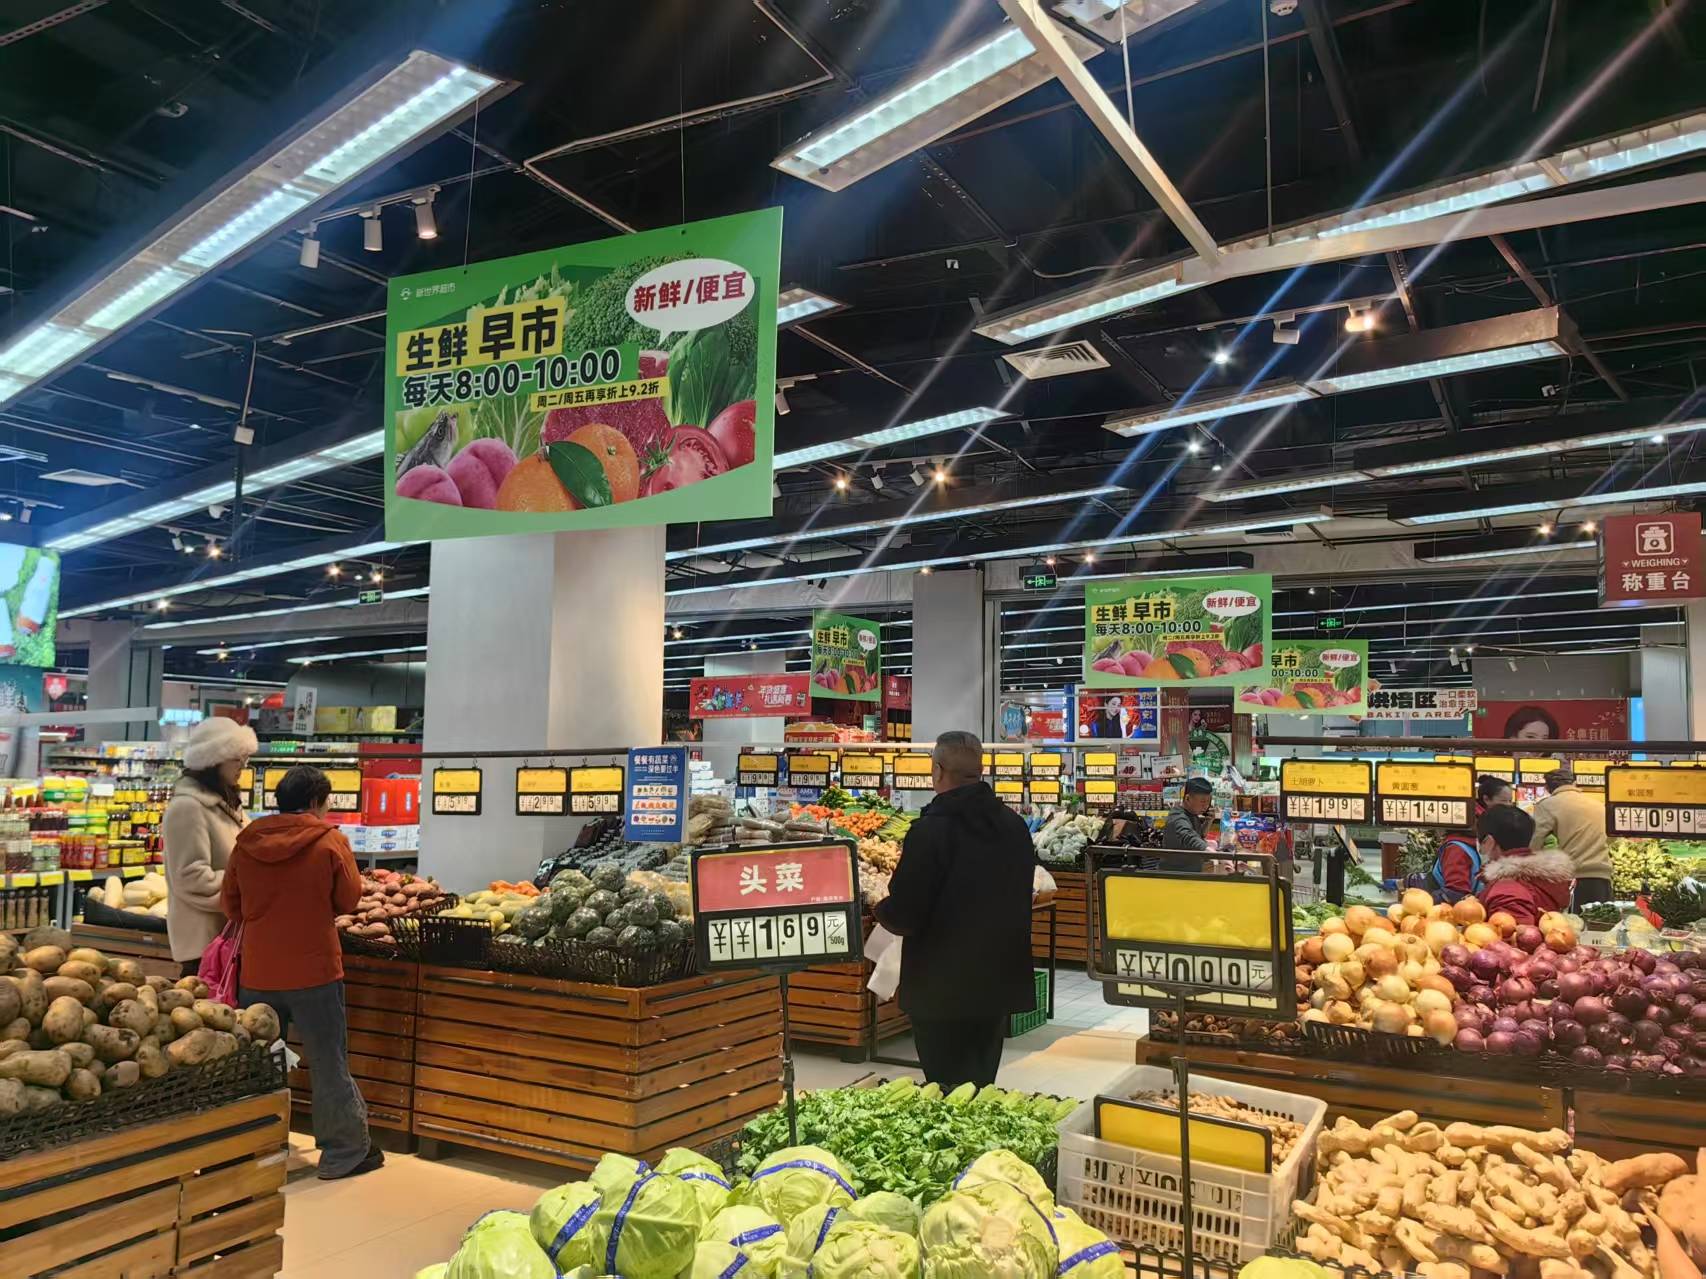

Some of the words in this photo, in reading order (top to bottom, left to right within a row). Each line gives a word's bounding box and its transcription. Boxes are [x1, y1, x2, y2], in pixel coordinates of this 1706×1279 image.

[633, 270, 746, 313] 新鲜/便宜
[403, 348, 621, 408] 每天8:00-10:00
[537, 381, 660, 409] 周二/周五再享折上9.2折
[1631, 558, 1680, 568] WEIGHING
[1621, 571, 1690, 592] 称重台
[1206, 596, 1257, 609] 新鲜/便宜
[1095, 620, 1201, 636] 每天8:00-10:00
[1271, 654, 1297, 668] 早市
[1424, 711, 1462, 719] AREA
[739, 862, 804, 896] 头菜
